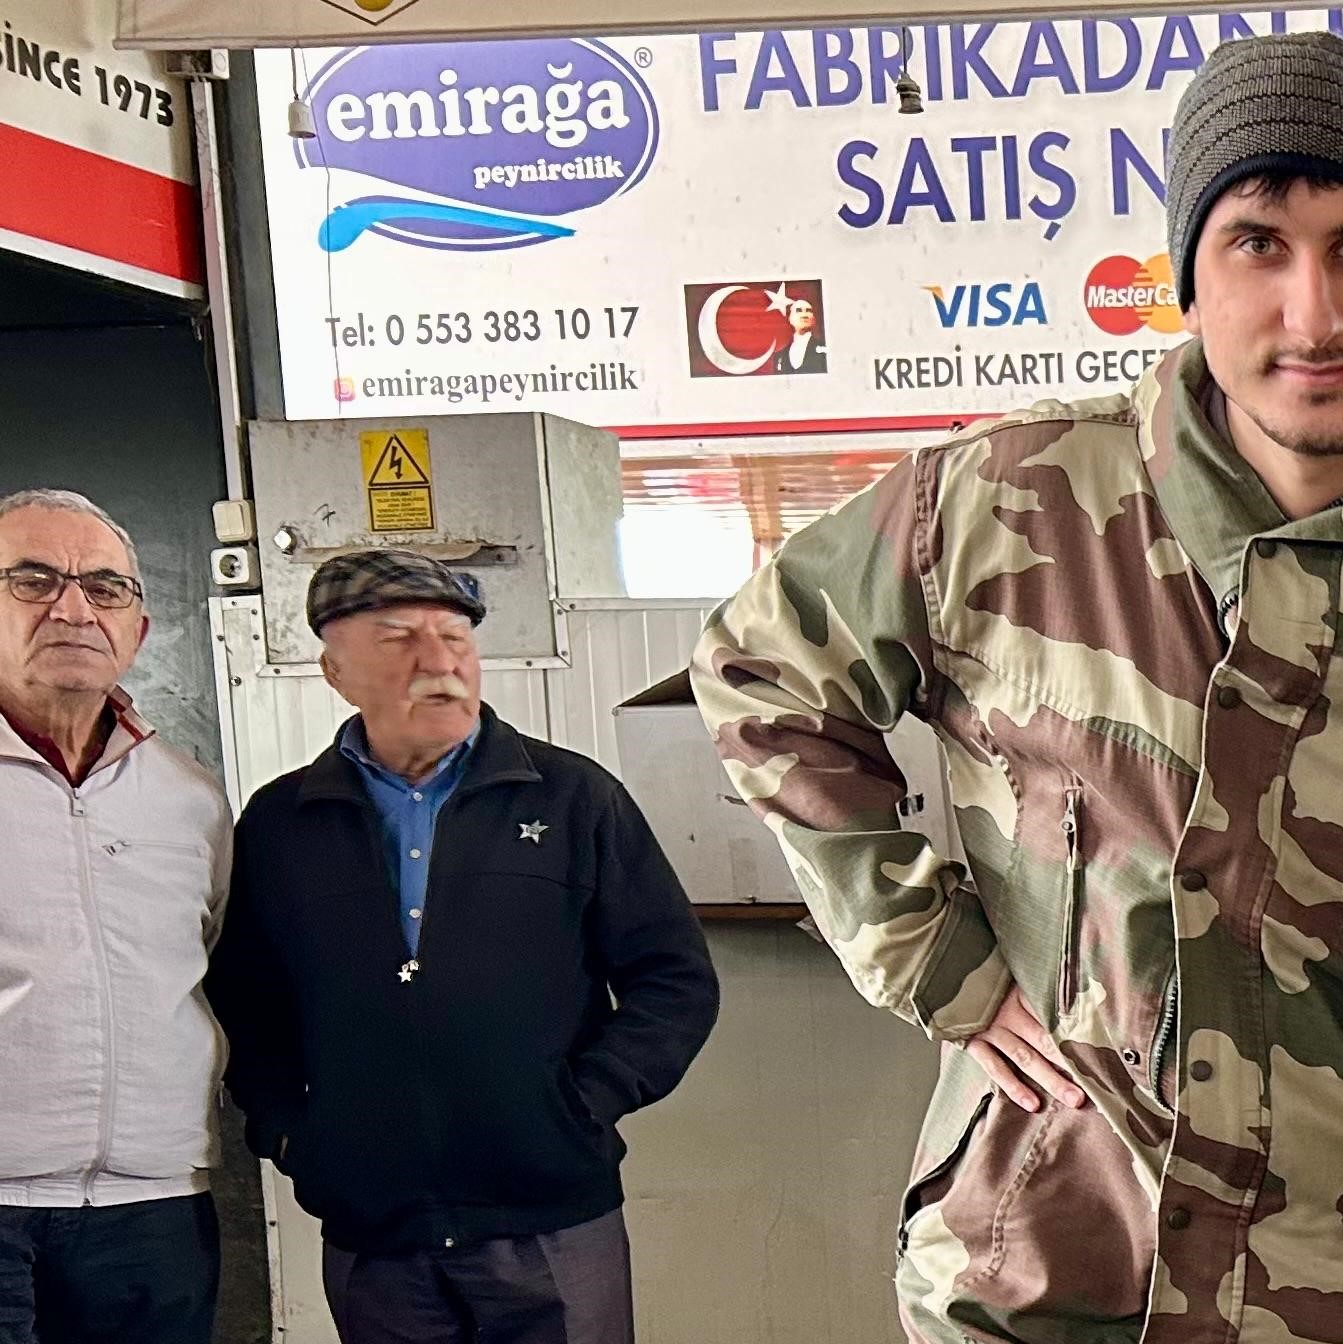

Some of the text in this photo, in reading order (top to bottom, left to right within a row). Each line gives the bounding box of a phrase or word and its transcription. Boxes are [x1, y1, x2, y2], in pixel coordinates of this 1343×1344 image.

[0, 20, 174, 127] İNCE 1973
[326, 62, 631, 149] emirağa
[473, 155, 625, 190] peynircilik
[837, 130, 1077, 240] SATIŞ
[921, 281, 1048, 329] VISA
[1087, 284, 1178, 308] MasterCa
[325, 305, 640, 348] Tel: 0 553 383 10 17
[362, 362, 639, 404] emiragapeynircilik
[873, 344, 962, 390] KREDİ
[974, 351, 1065, 387] KARTI
